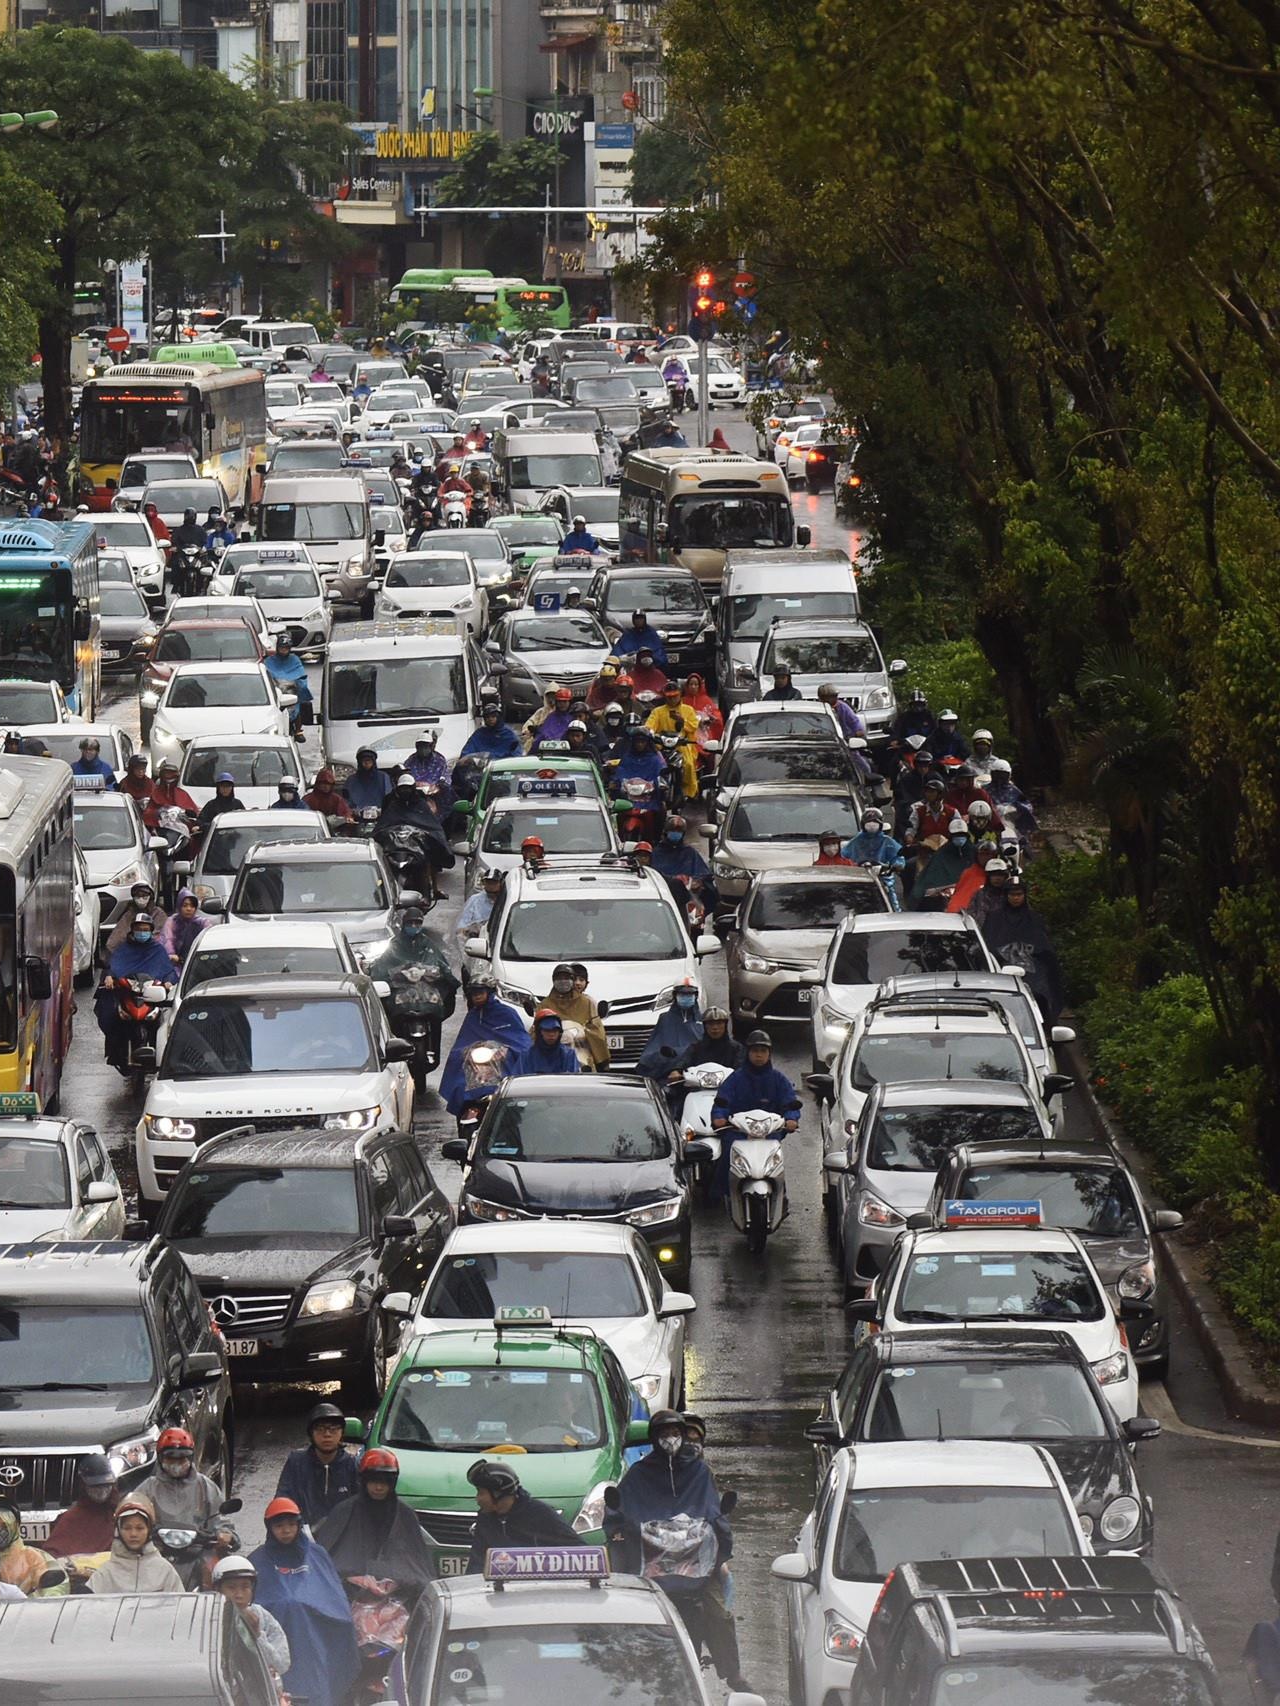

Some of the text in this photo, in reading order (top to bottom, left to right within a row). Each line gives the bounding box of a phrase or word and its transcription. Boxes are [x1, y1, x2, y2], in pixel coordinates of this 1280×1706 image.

[353, 178, 368, 190] Sales
[540, 595, 554, 608] G7
[959, 1206, 1037, 1215] TAXIGROUP
[502, 1308, 543, 1319] TAXI
[224, 1340, 256, 1355] 31.87
[442, 1559, 468, 1575] 51F
[516, 1550, 600, 1573] MỸ ĐÌNH
